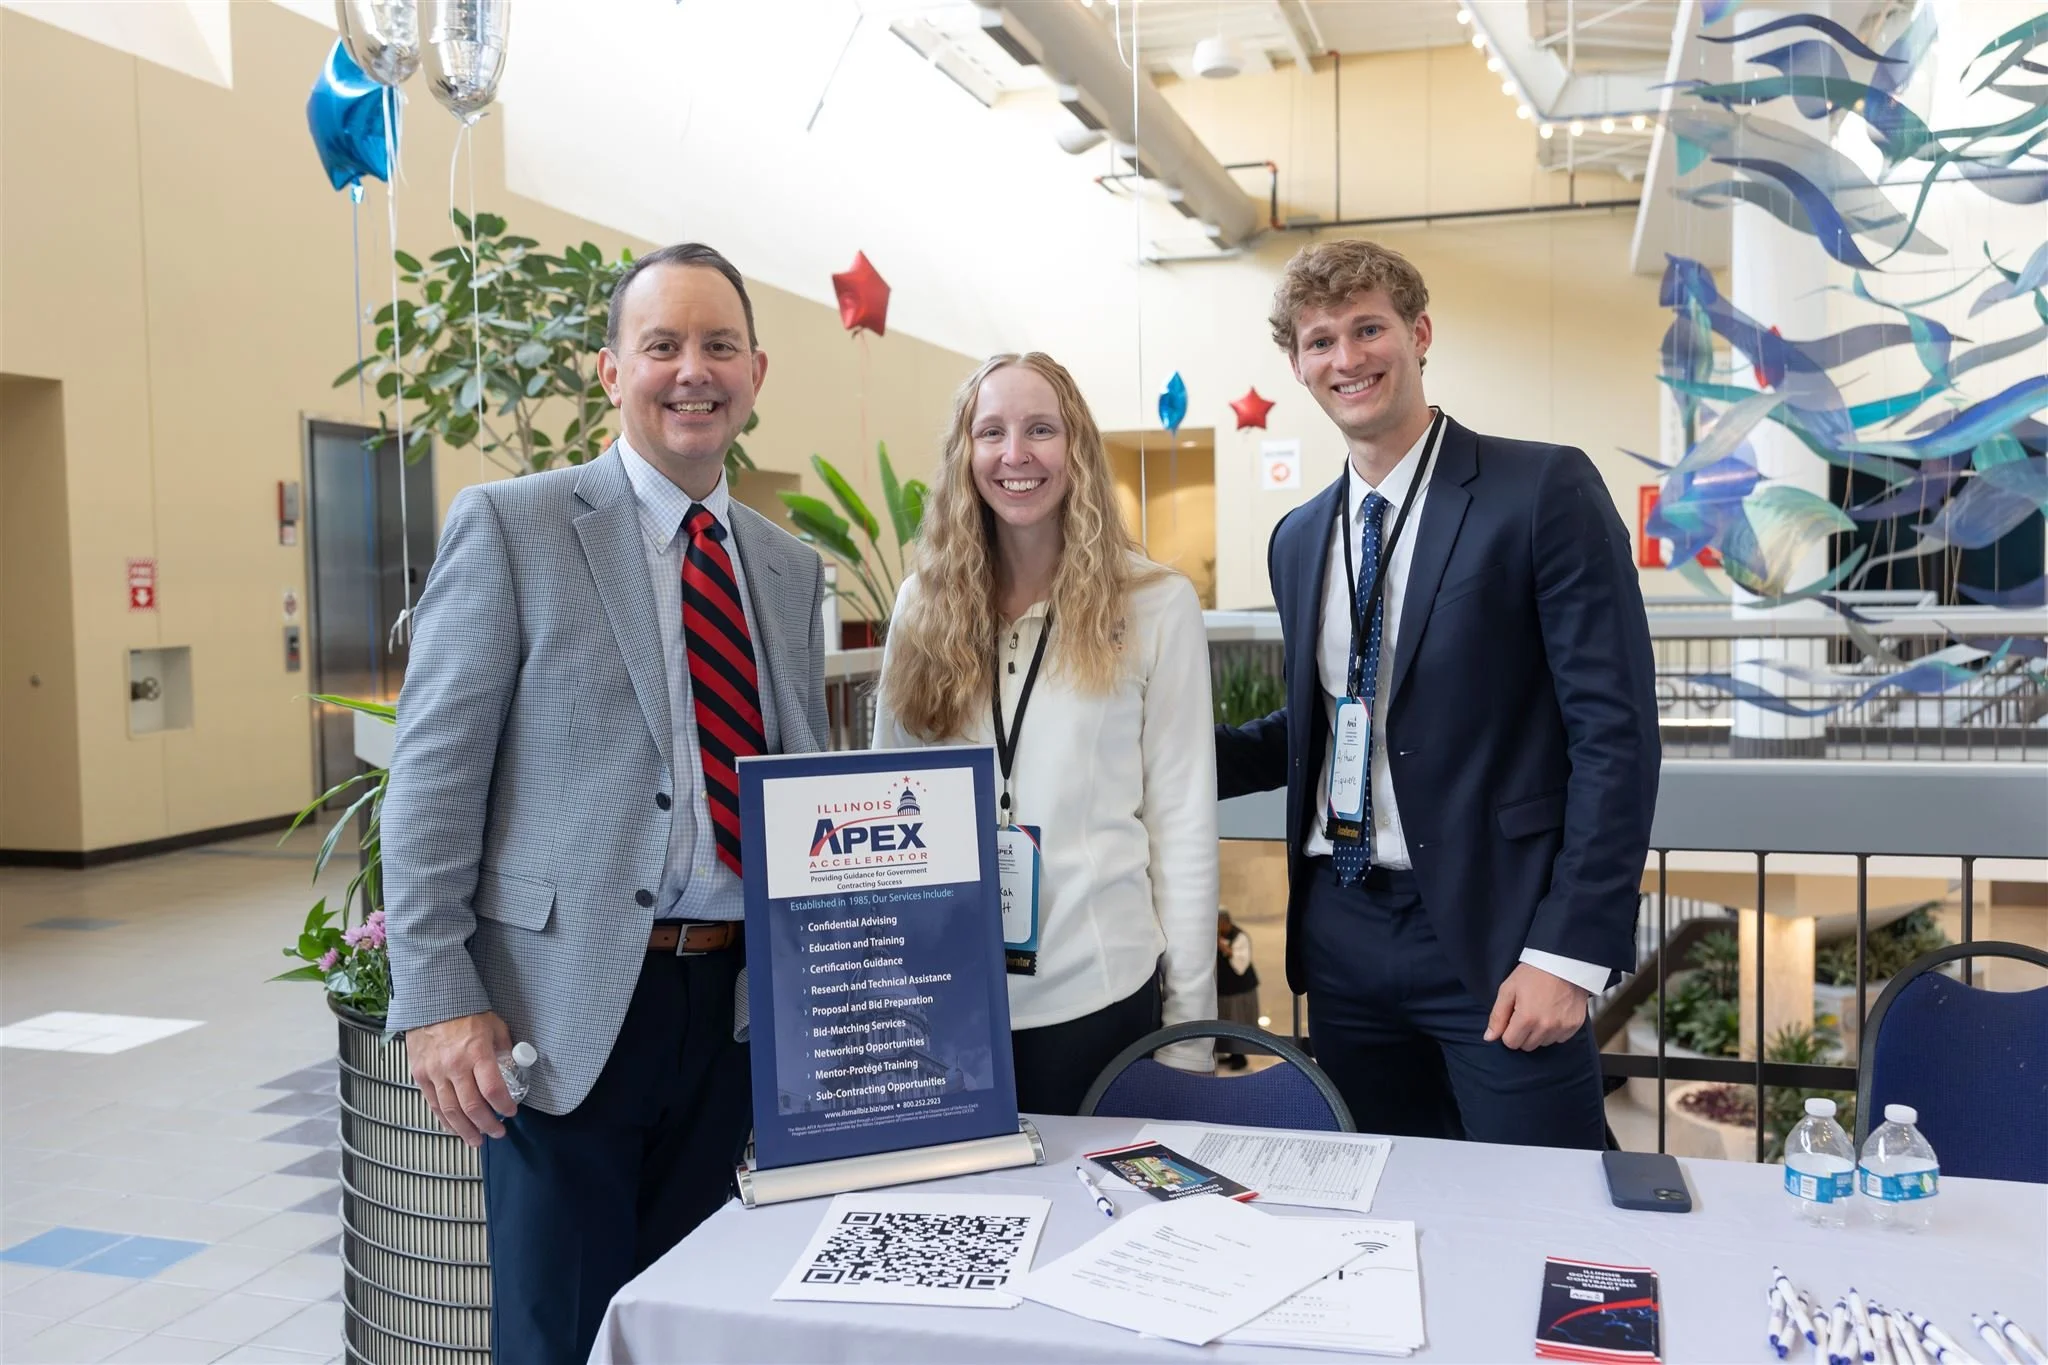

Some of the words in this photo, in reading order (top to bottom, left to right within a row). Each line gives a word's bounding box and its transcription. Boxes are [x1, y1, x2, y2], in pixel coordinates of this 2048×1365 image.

[818, 800, 892, 814] ILLINOIS
[809, 818, 926, 856] APEX
[809, 852, 928, 868] ACCELERATOR
[810, 874, 842, 883] Providing
[844, 871, 874, 880] Guidance
[876, 870, 886, 878] for
[886, 867, 927, 876] Government
[837, 880, 876, 890] Contracting
[877, 878, 902, 887] Success
[790, 898, 836, 911] Established
[838, 898, 846, 907] in
[849, 894, 870, 906] 1985,
[872, 894, 887, 904] Our
[889, 890, 922, 902] Services
[922, 888, 954, 900] Include:
[808, 918, 859, 932] Confidential
[861, 916, 898, 927] Advising
[809, 940, 851, 953] Education
[853, 938, 869, 949] and
[870, 936, 905, 948] Training
[810, 960, 862, 974] Certification
[863, 956, 903, 968] Guidance
[811, 982, 849, 996] Research
[850, 980, 867, 991] and
[868, 976, 907, 988] Technical
[908, 972, 952, 984] Assistance
[812, 1004, 849, 1016] Proposal
[851, 1001, 867, 1012] and
[868, 999, 883, 1010] Bid
[884, 994, 934, 1008] Preparation
[813, 1022, 870, 1038] Bid-Matching
[872, 1019, 906, 1030] Services
[814, 1044, 864, 1058] Networking
[866, 1038, 924, 1053] Opportunities
[816, 1062, 882, 1080] Mentor-Protégé
[884, 1058, 918, 1071] Training
[816, 1082, 886, 1101] Sub-Contracting
[887, 1076, 946, 1092] Opportunities
[902, 1098, 941, 1108] 800.252.2923
[1566, 1276, 1638, 1288] CONTRACTING
[1568, 1272, 1635, 1283] GOVERNMENT
[1583, 1270, 1620, 1278] ILLINOIS
[1582, 1282, 1620, 1292] SUMMIT
